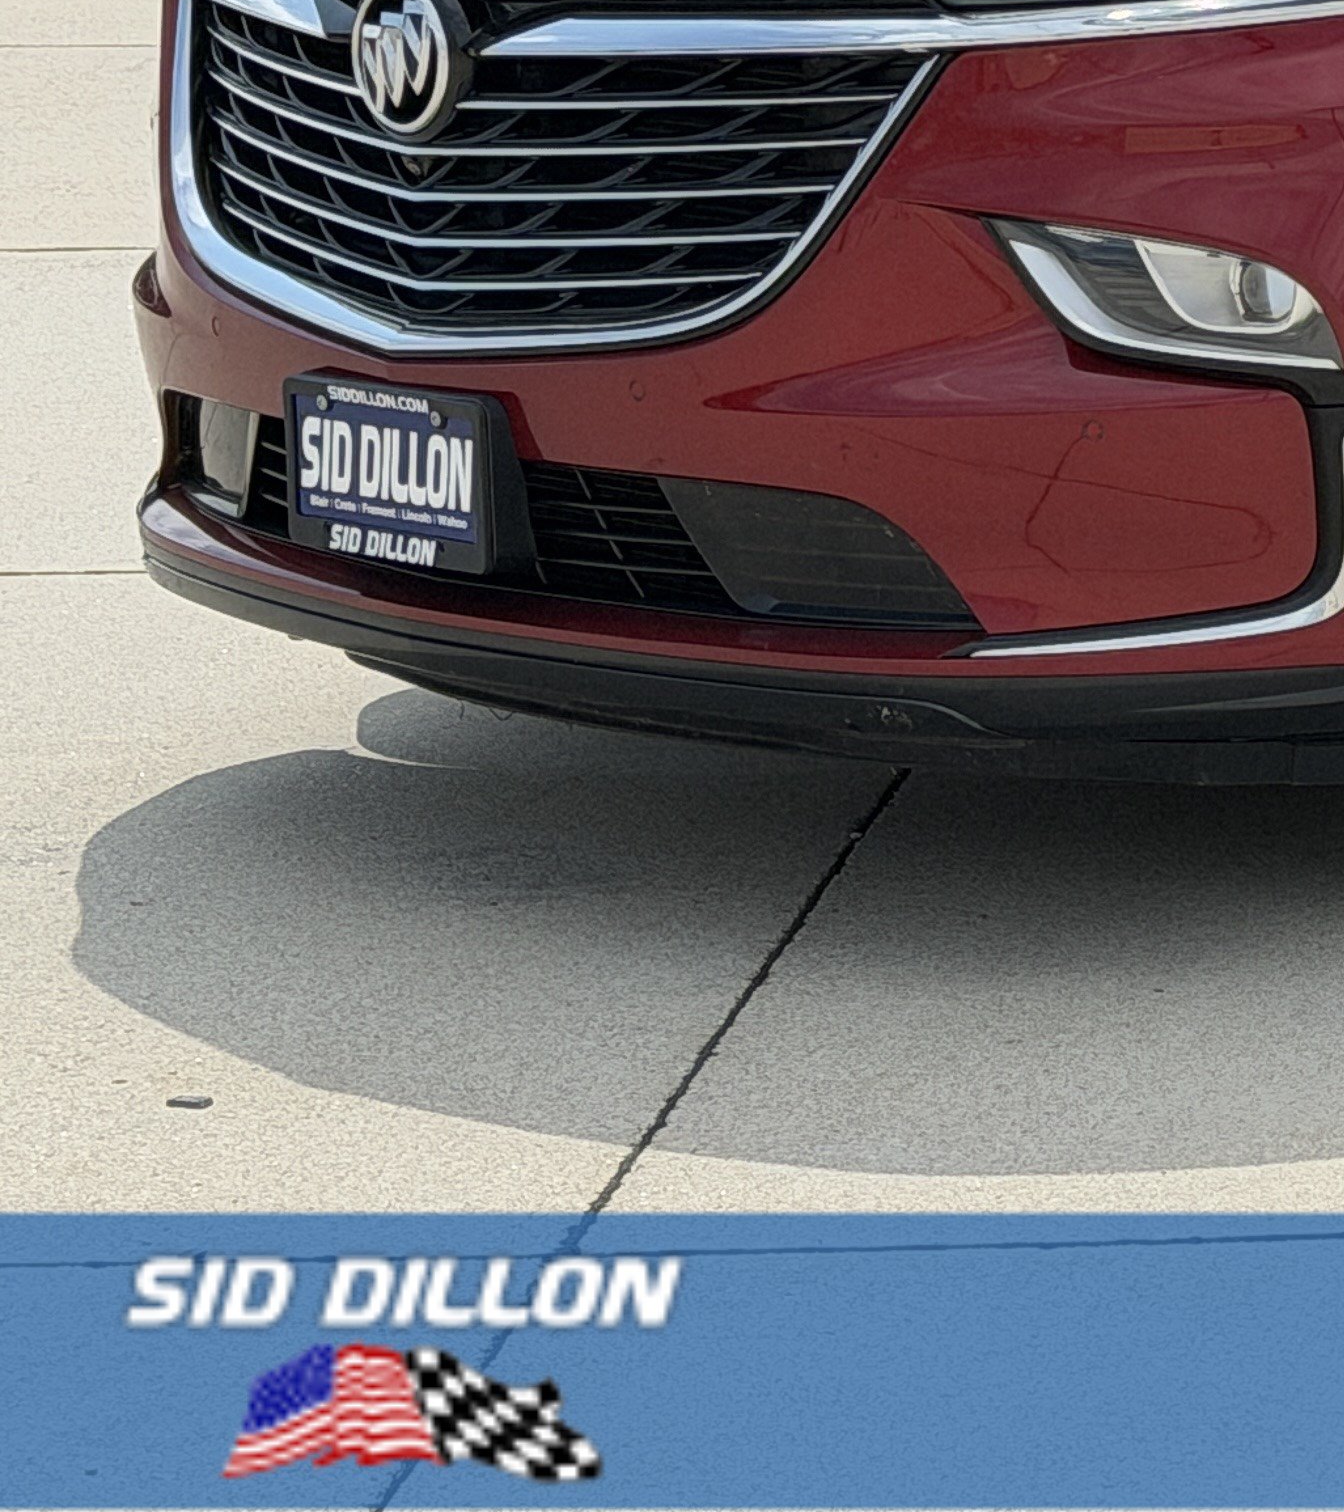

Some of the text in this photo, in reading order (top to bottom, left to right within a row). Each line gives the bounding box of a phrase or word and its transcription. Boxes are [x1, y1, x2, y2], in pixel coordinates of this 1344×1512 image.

[327, 385, 429, 414] SIDDILLON.COM
[301, 415, 474, 513] SID DILLON
[329, 523, 437, 568] SID DILLON
